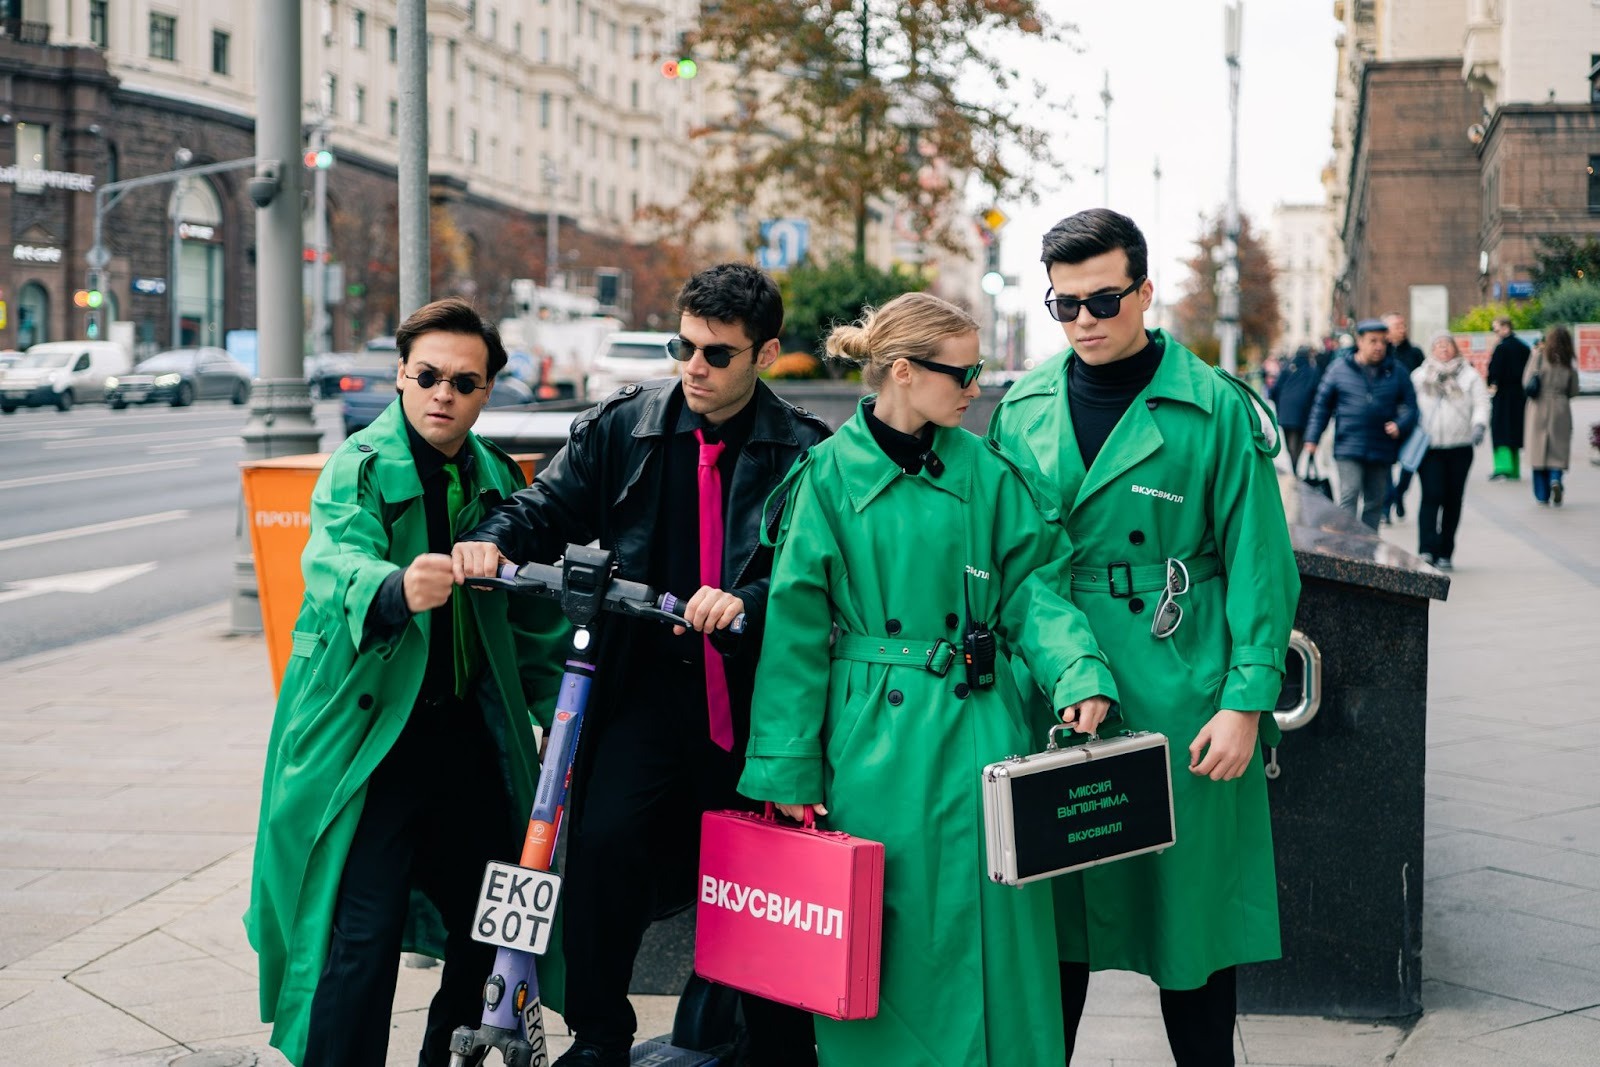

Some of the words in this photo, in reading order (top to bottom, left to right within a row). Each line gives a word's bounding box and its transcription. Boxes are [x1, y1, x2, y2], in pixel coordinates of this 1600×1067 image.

[1131, 484, 1184, 503] ВКУСВИЛЛ
[1068, 780, 1112, 799] МИССИЯ
[1057, 793, 1129, 818] ВЫПОЛНИМА
[1068, 822, 1122, 843] ВКУСВИЛЛ
[701, 875, 843, 939] ВКУСВИЛЛ
